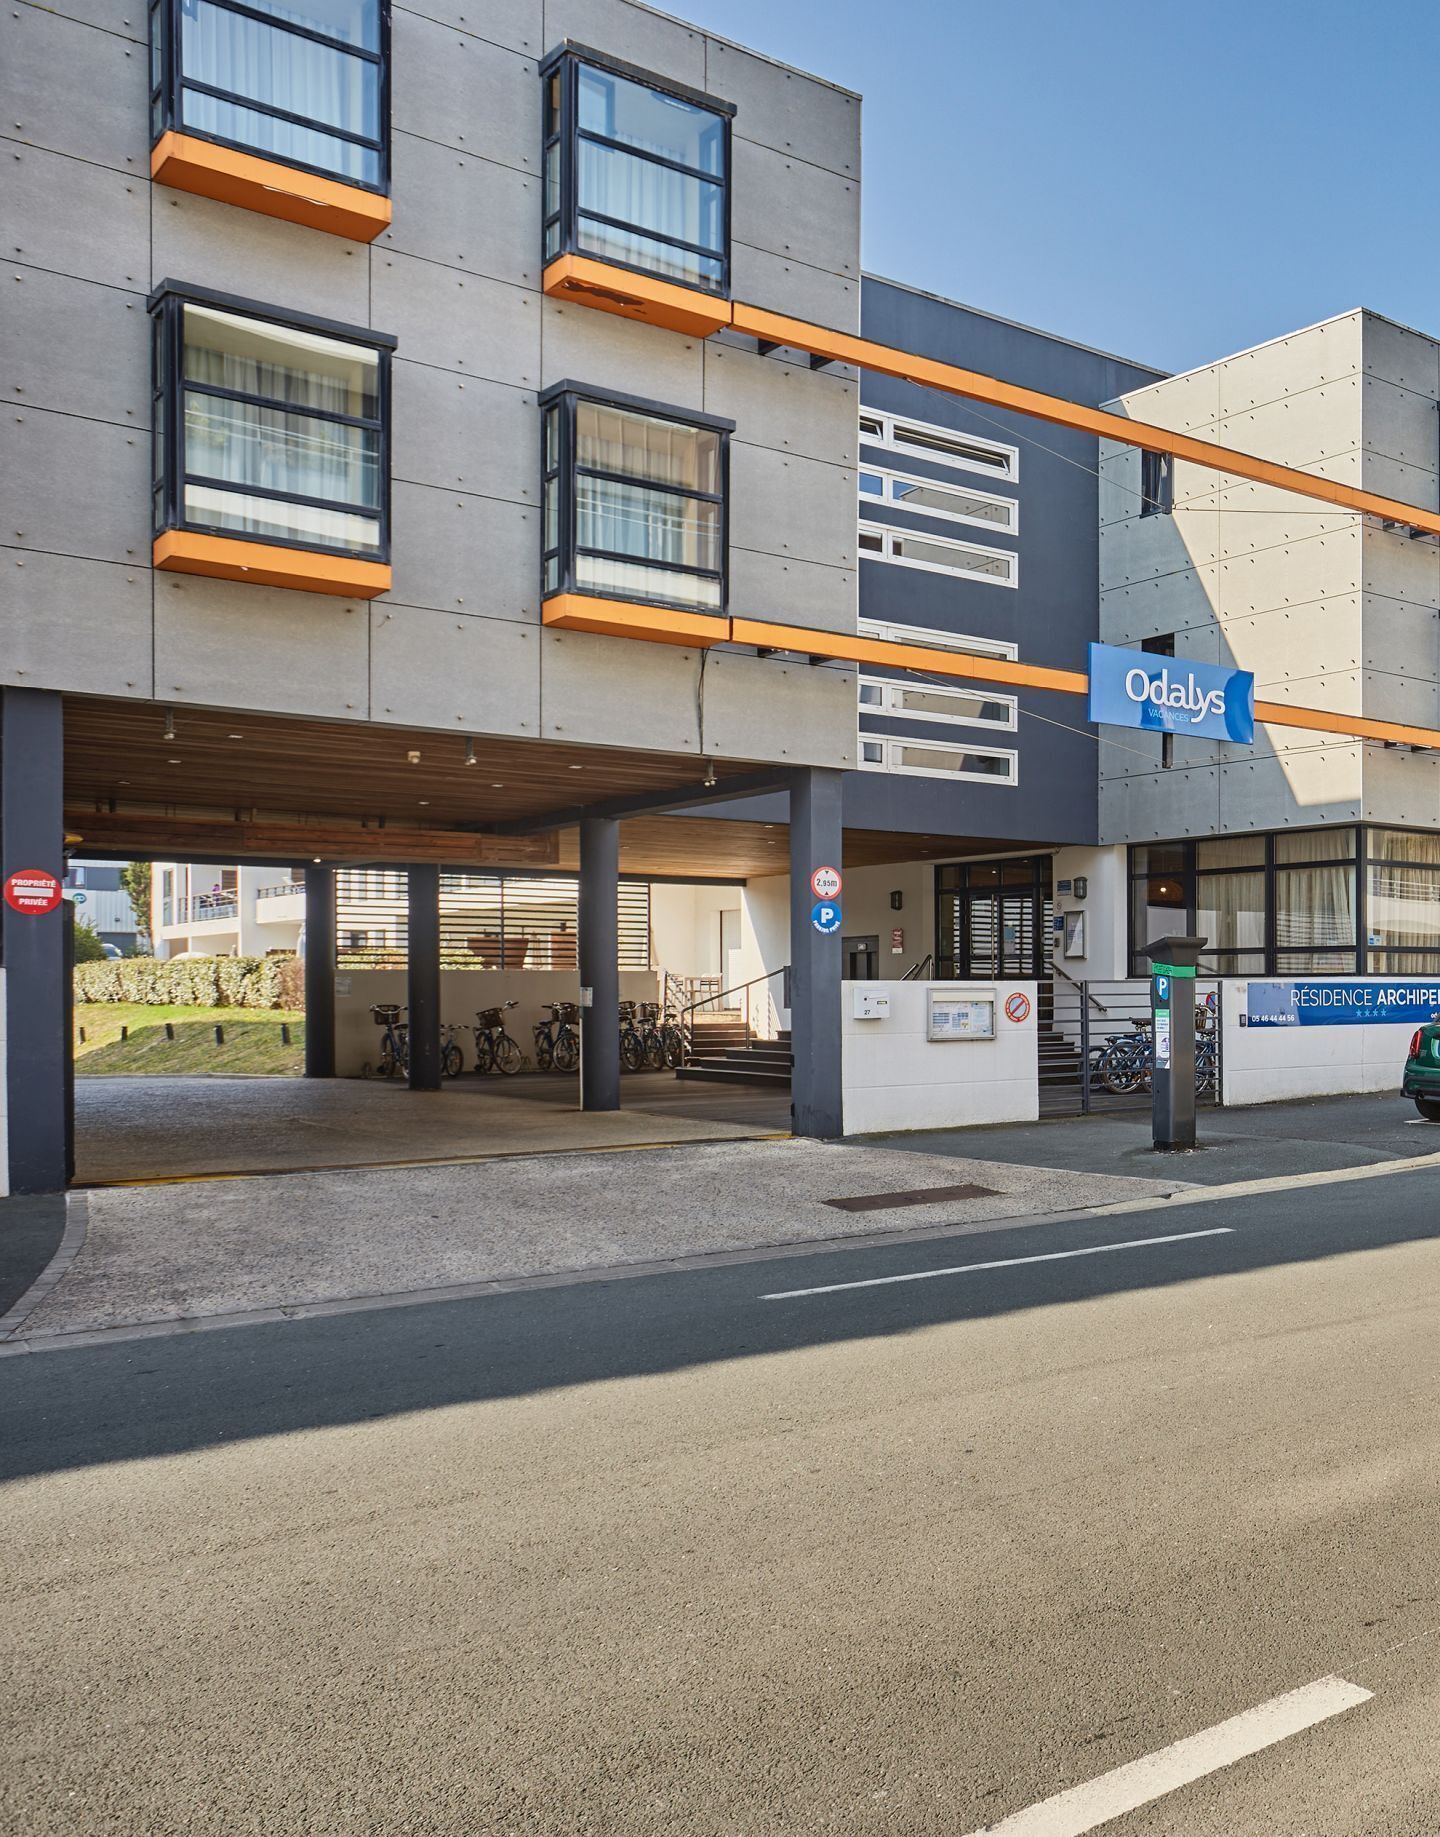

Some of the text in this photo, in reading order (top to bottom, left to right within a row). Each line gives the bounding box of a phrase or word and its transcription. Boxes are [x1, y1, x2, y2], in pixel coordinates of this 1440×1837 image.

[1125, 668, 1226, 723] Odalys
[1148, 708, 1189, 722] VACANCES
[11, 878, 57, 888] PROPRIÉTÉ
[18, 898, 49, 906] PRIVÉE
[820, 907, 834, 924] P
[1159, 977, 1167, 996] P
[1290, 985, 1373, 1006] RÉSIDENCE
[1251, 1015, 1260, 1023] 05
[1286, 1014, 1295, 1022] 56
